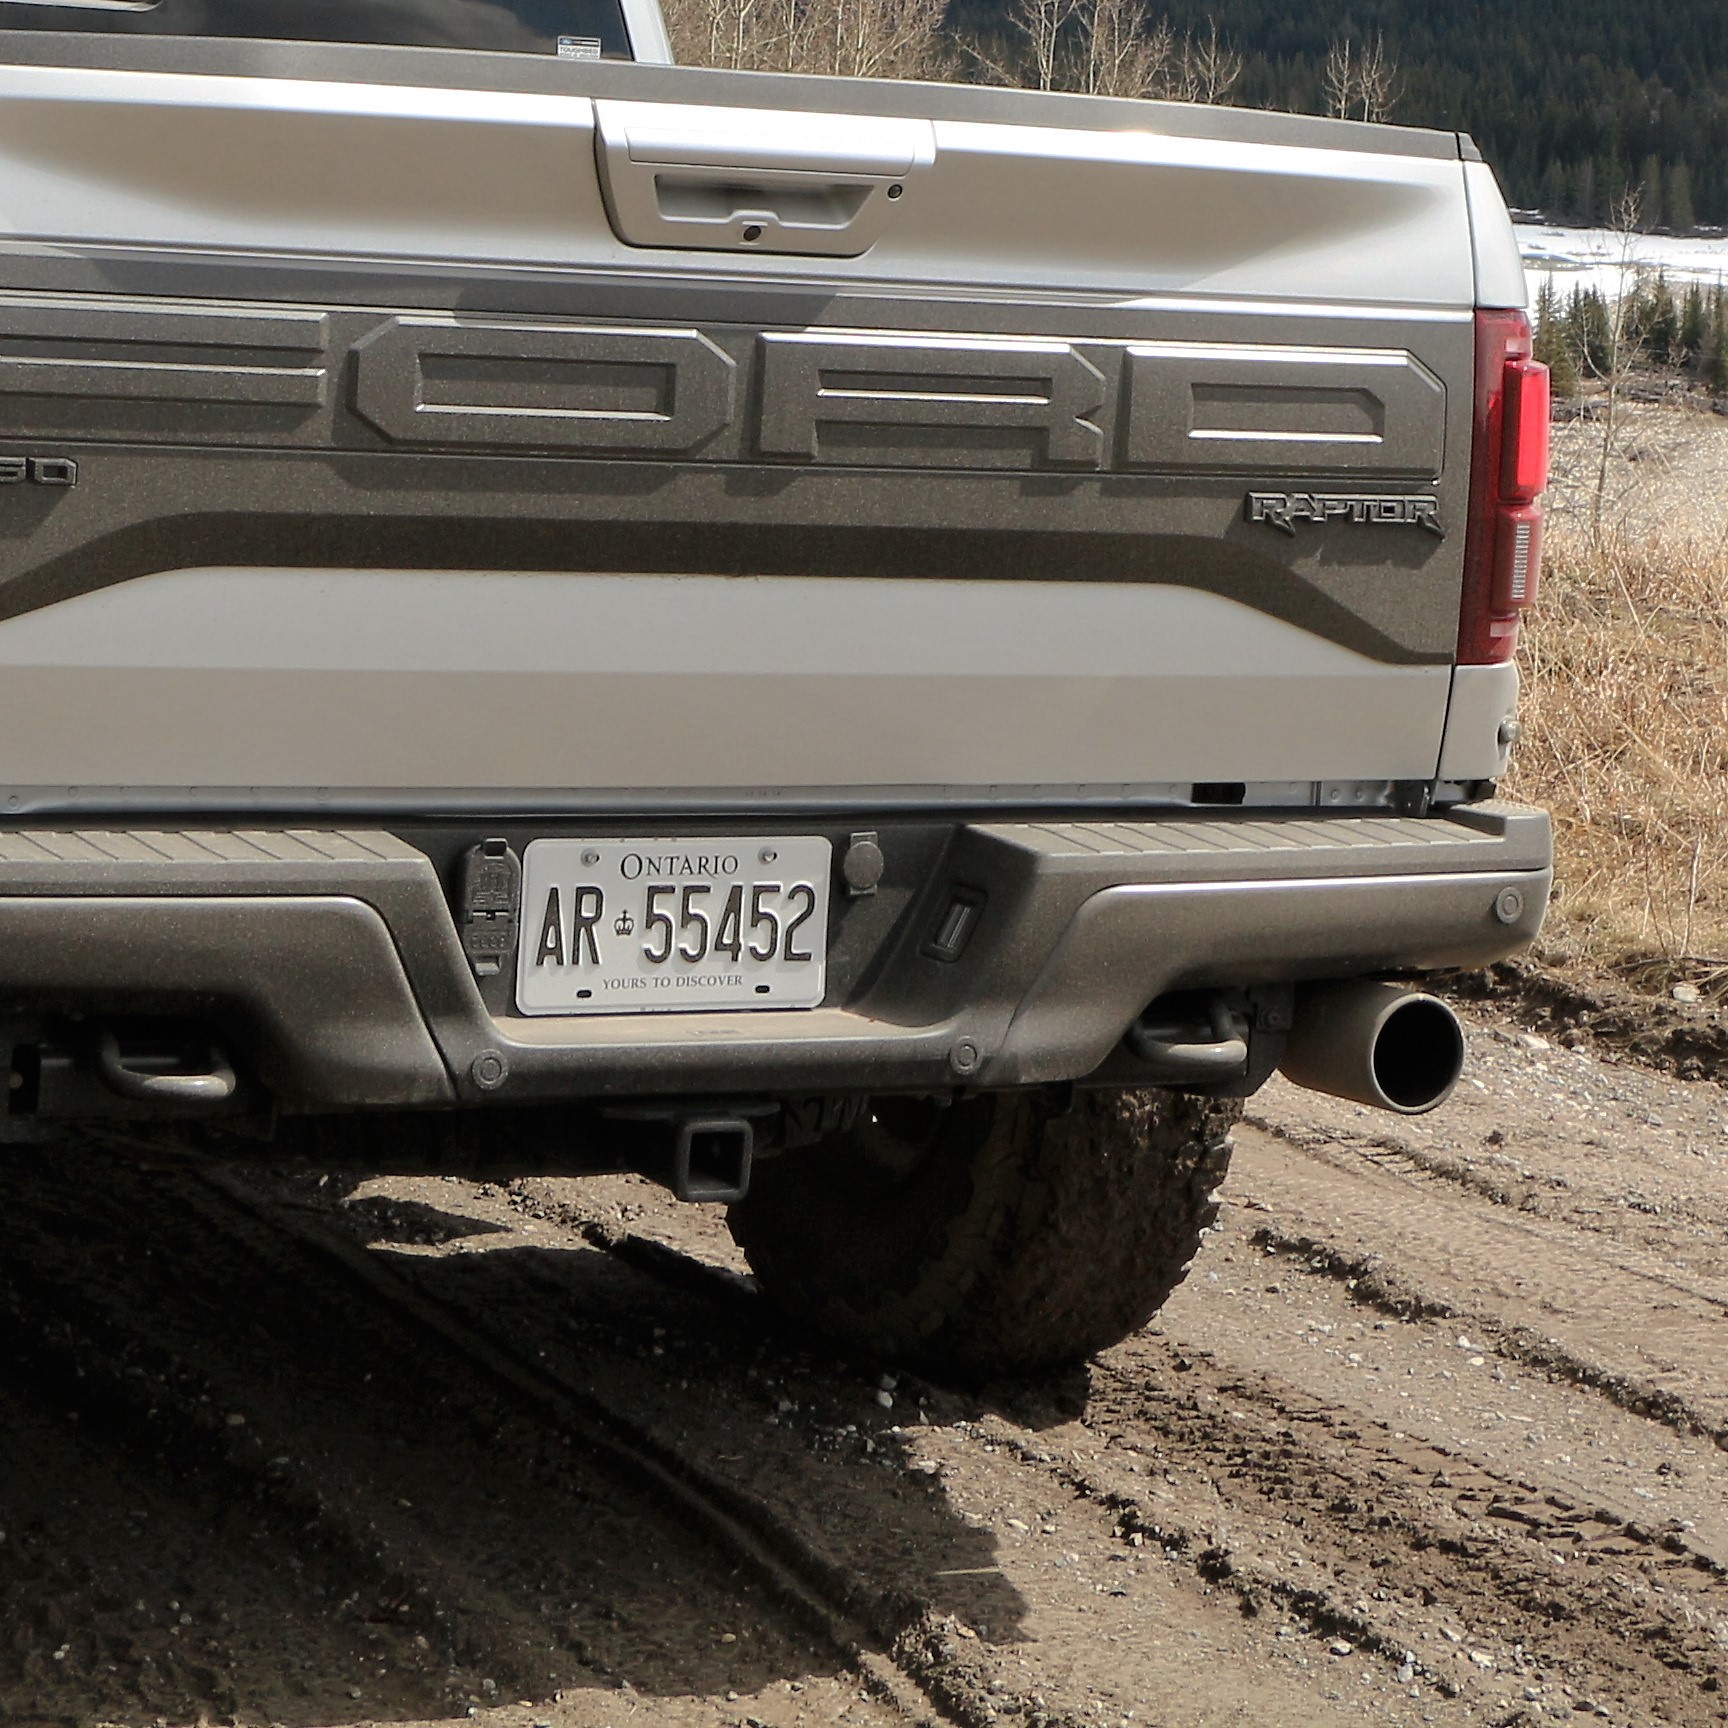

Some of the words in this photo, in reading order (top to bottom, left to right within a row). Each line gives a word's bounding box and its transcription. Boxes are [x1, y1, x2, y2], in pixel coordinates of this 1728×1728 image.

[1245, 491, 1446, 541] RAPTOR
[535, 885, 605, 966] AR
[643, 884, 817, 964] 55452
[602, 978, 647, 990] YOURS
[652, 977, 671, 989] TO
[676, 975, 743, 988] DISCOVER
